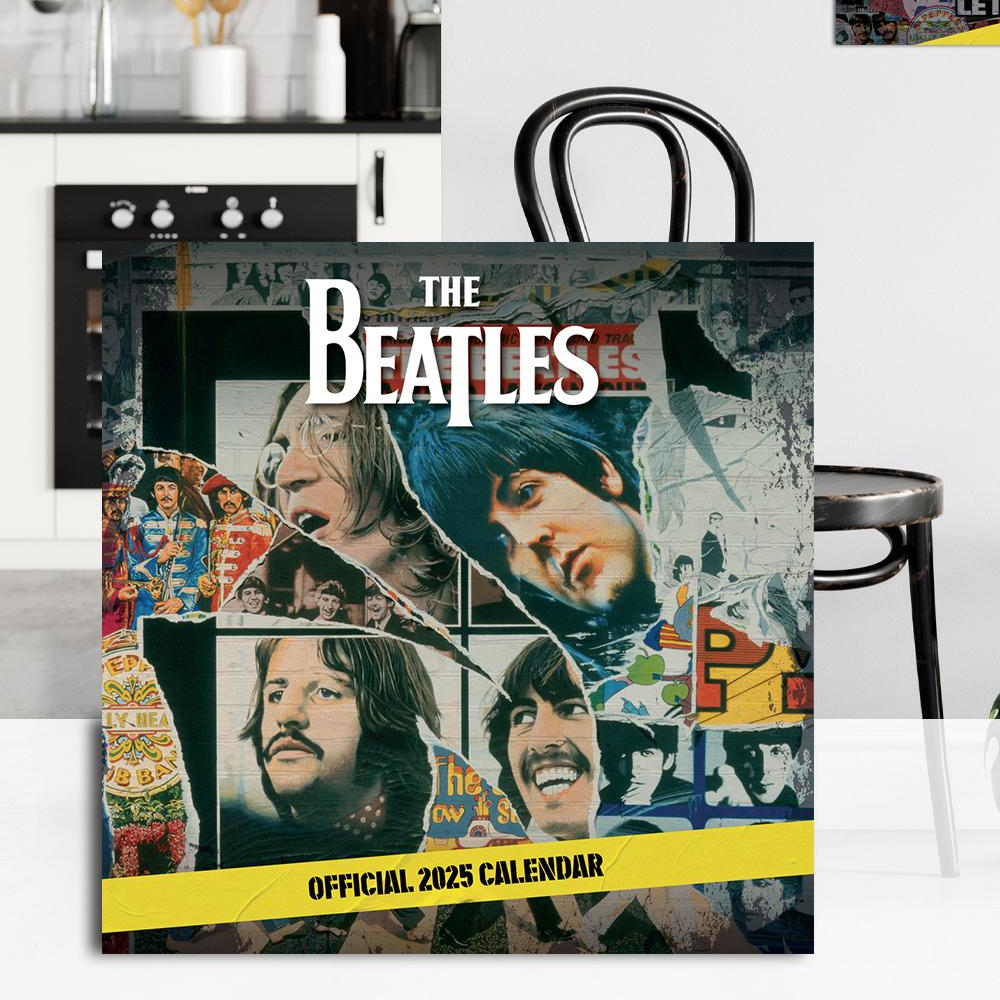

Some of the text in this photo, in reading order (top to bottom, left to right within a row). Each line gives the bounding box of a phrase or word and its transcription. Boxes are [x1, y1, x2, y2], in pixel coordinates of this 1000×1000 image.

[418, 275, 481, 308] THE
[304, 277, 600, 428] BEATLES
[308, 852, 604, 901] OFFICIAL 2025 CALENDAR
